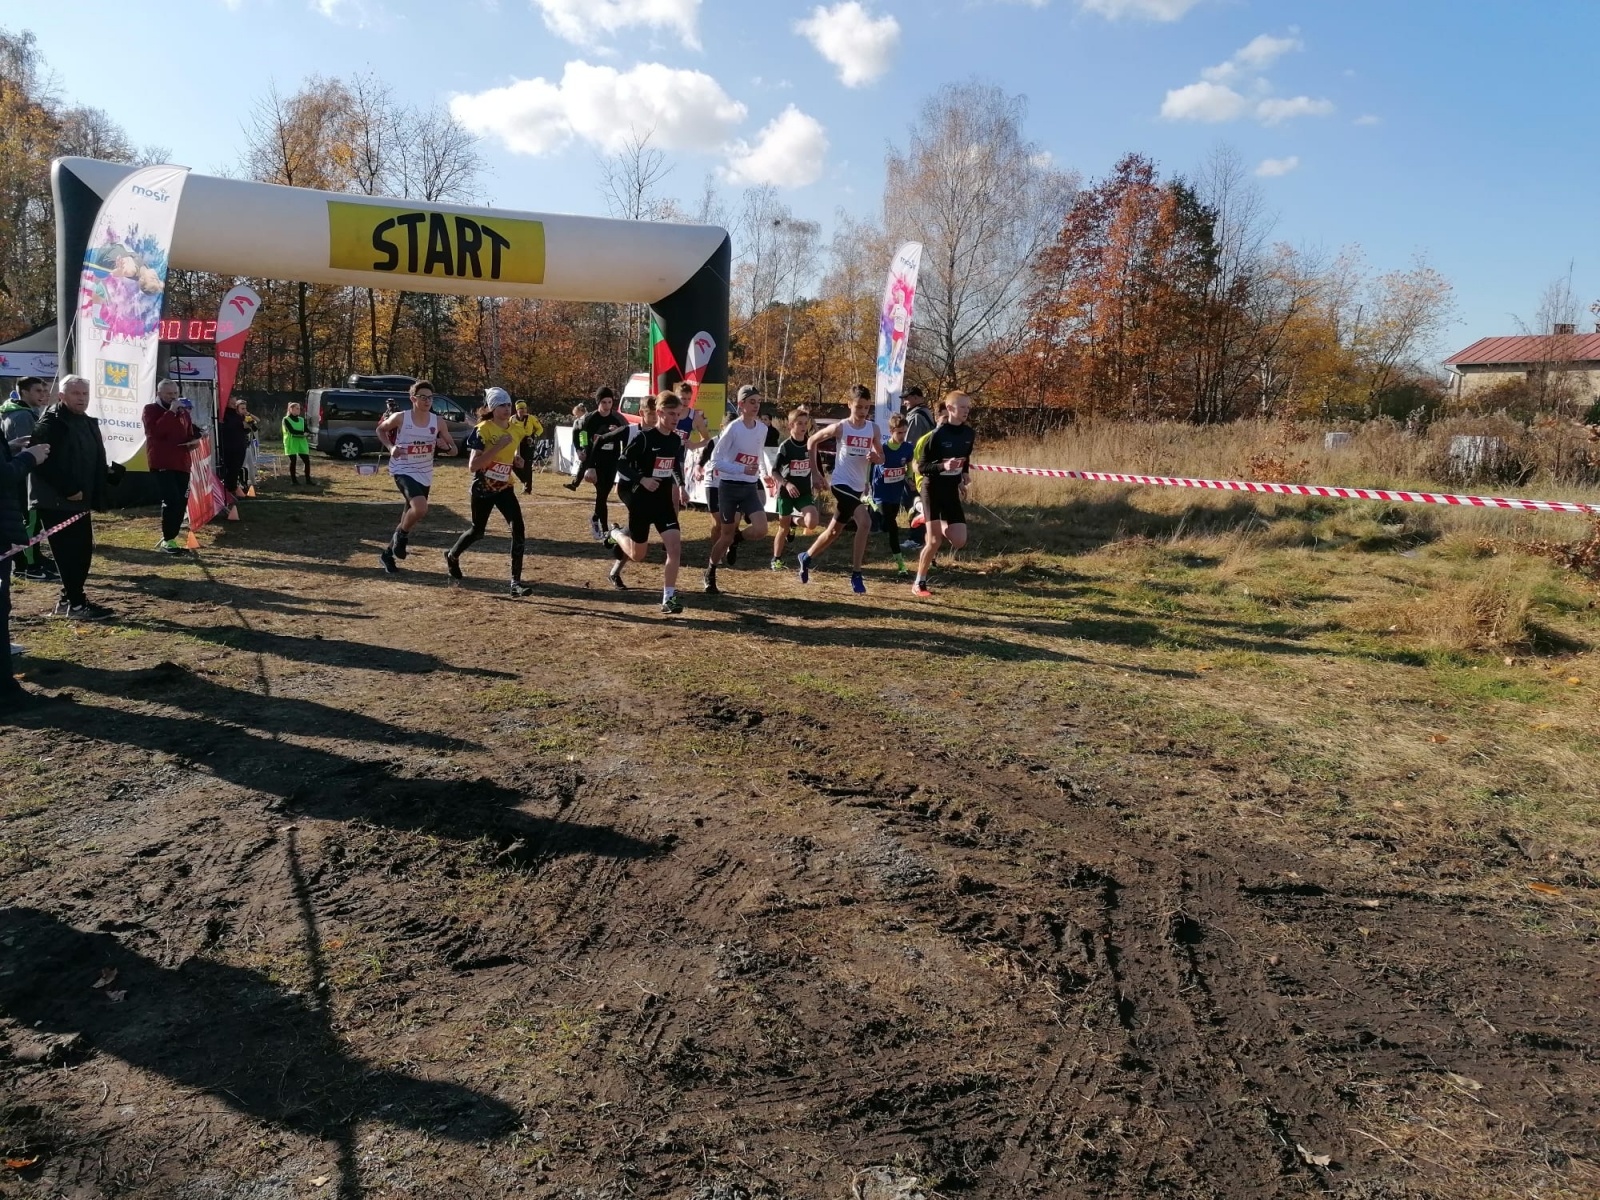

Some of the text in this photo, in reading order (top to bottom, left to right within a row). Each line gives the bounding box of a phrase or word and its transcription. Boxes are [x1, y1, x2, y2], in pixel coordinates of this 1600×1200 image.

[132, 185, 170, 202] mosir
[372, 212, 511, 279] START
[188, 321, 217, 340] 02
[219, 351, 240, 359] ORLEN
[98, 418, 142, 429] OPOLSKIE
[107, 435, 134, 443] OPOLE
[850, 436, 869, 447] 416
[411, 445, 429, 454] 414
[491, 463, 511, 474] 400
[658, 459, 673, 469] 401
[793, 461, 810, 470] 403
[887, 468, 903, 478] 410
